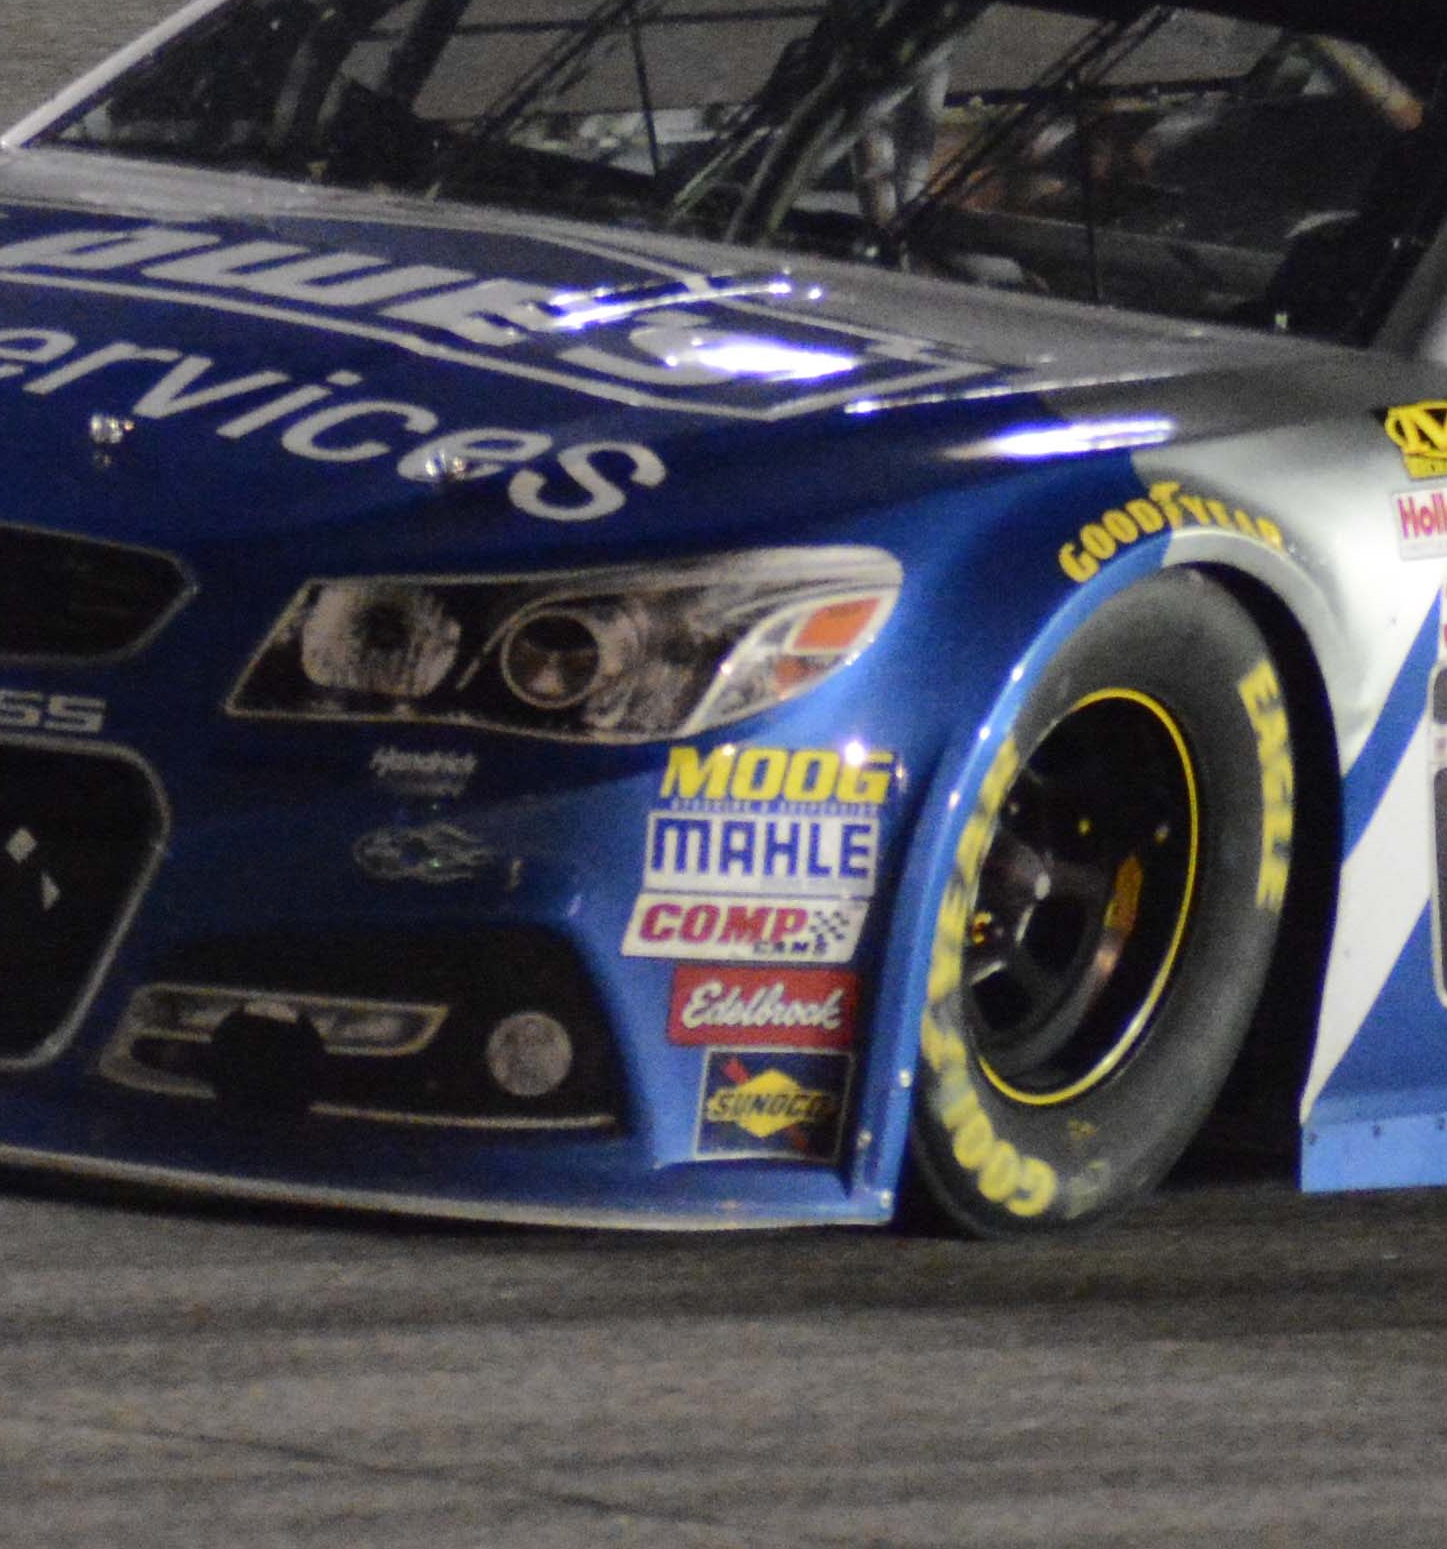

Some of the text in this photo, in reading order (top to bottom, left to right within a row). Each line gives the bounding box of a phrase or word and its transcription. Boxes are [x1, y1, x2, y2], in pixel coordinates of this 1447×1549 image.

[659, 745, 895, 805] MOOG
[650, 817, 872, 880] MAHLE
[637, 902, 809, 946] COMP
[680, 979, 846, 1032] Edelbrock
